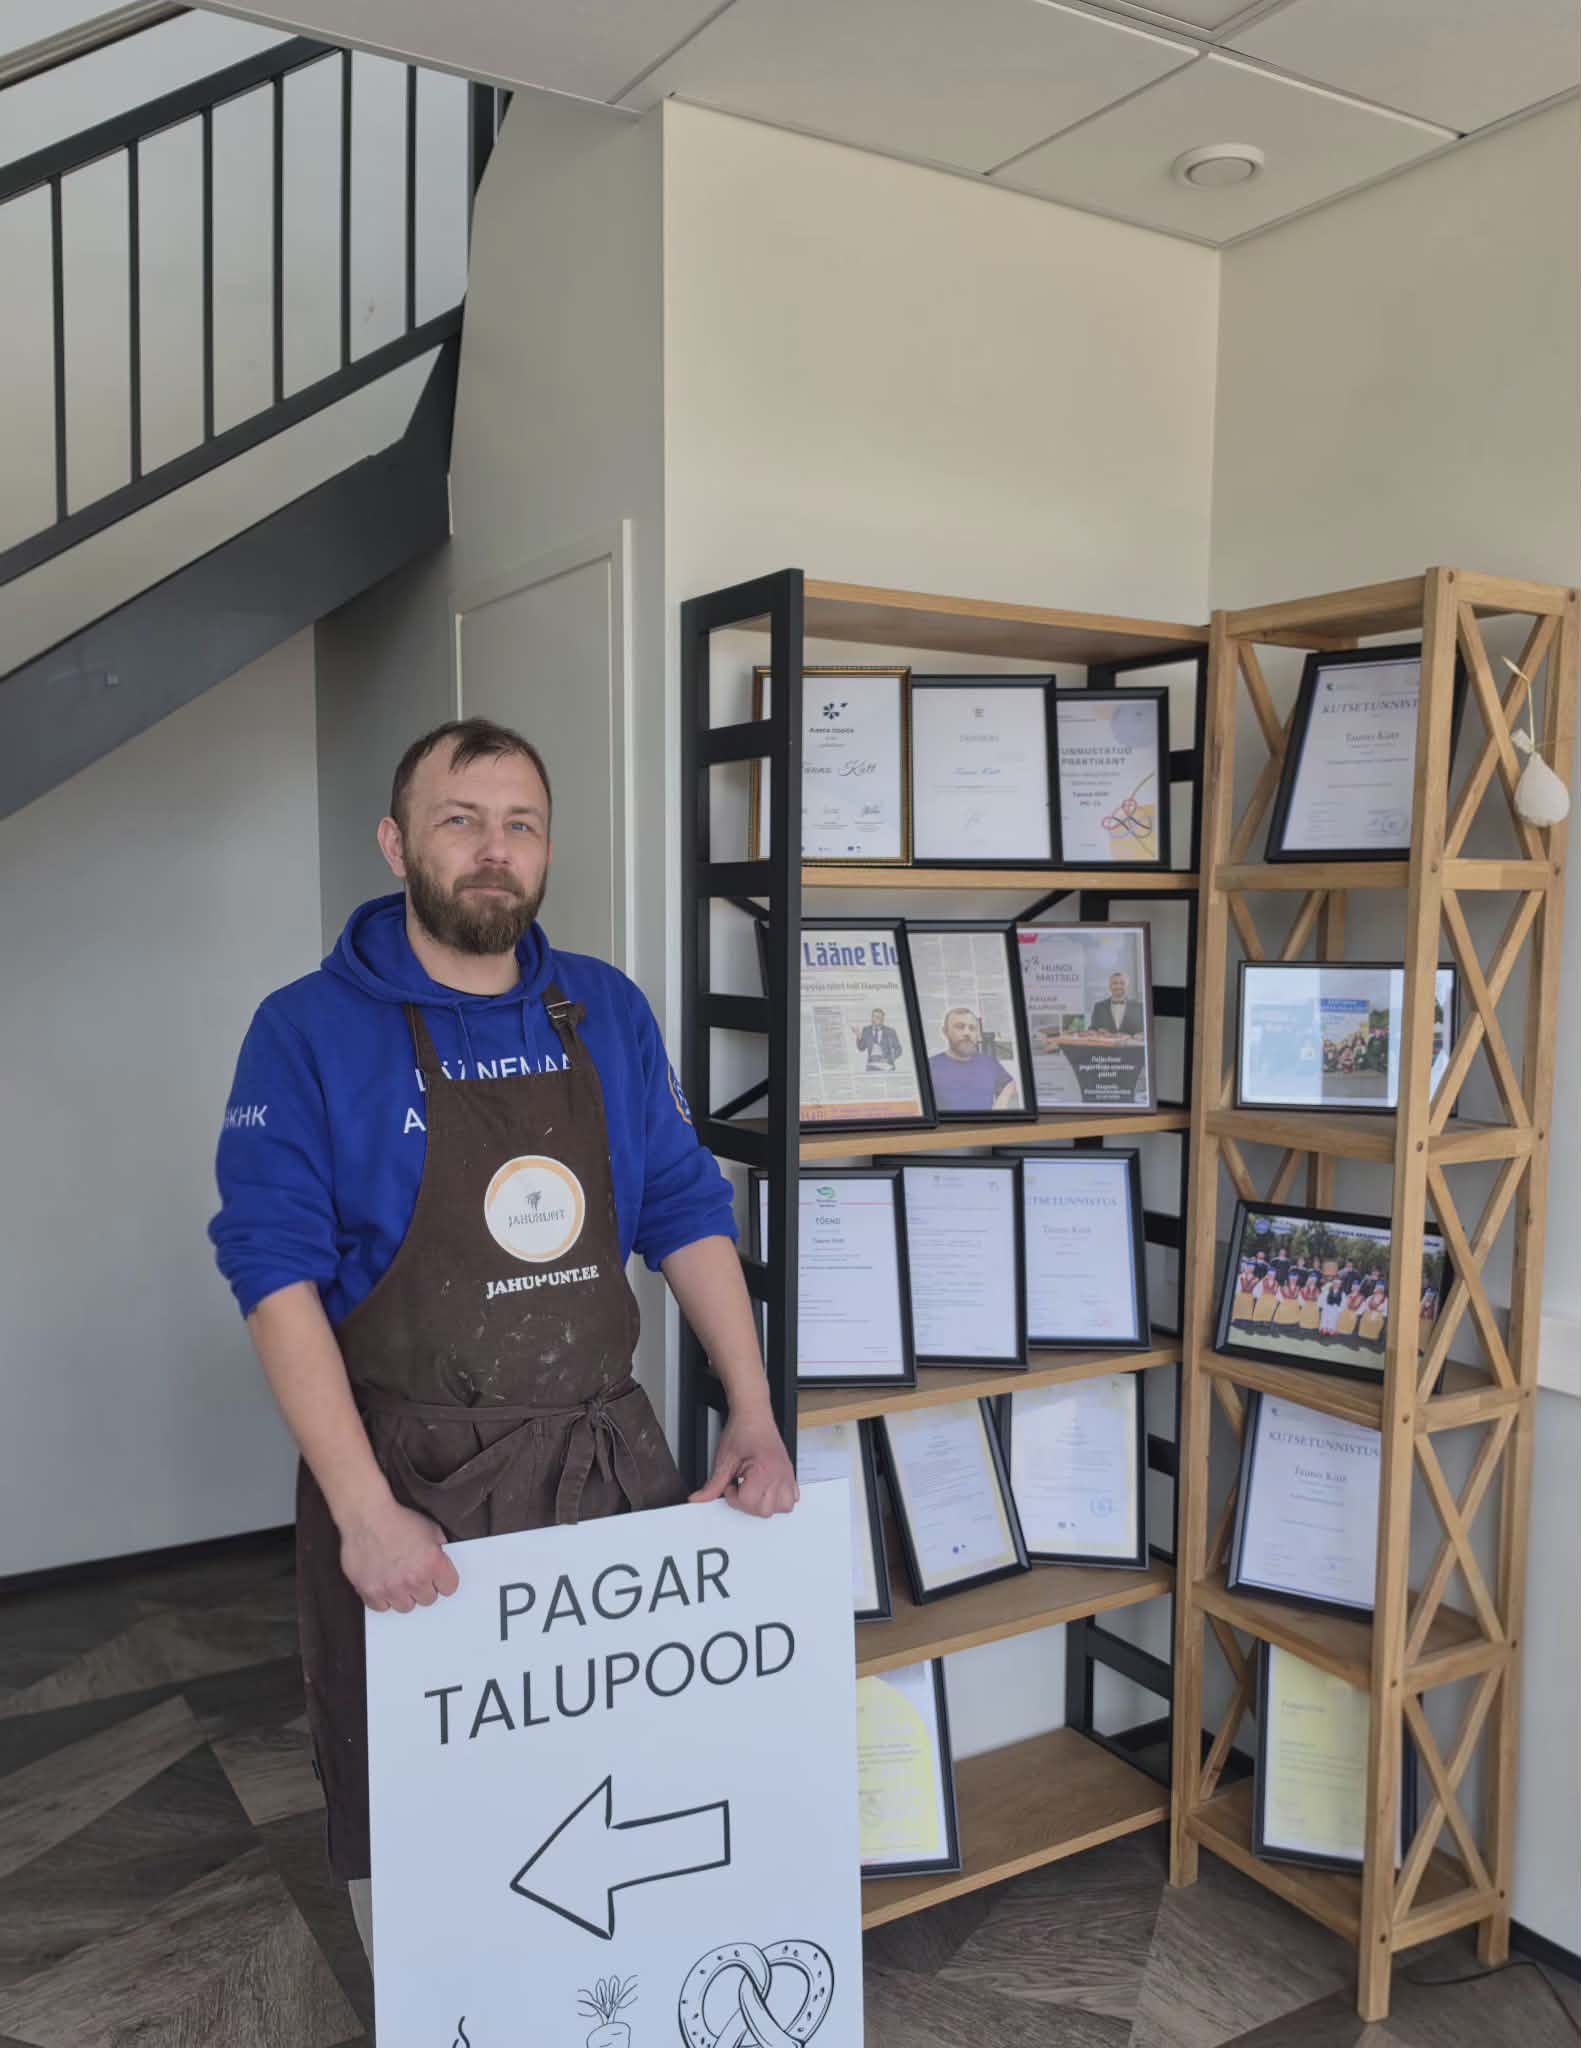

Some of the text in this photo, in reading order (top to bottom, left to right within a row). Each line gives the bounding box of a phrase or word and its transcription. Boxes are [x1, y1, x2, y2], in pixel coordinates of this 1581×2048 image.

[803, 942, 866, 967] Lääne
[498, 1547, 731, 1641] PAGAR
[424, 1621, 795, 1745] TALUPOOD
